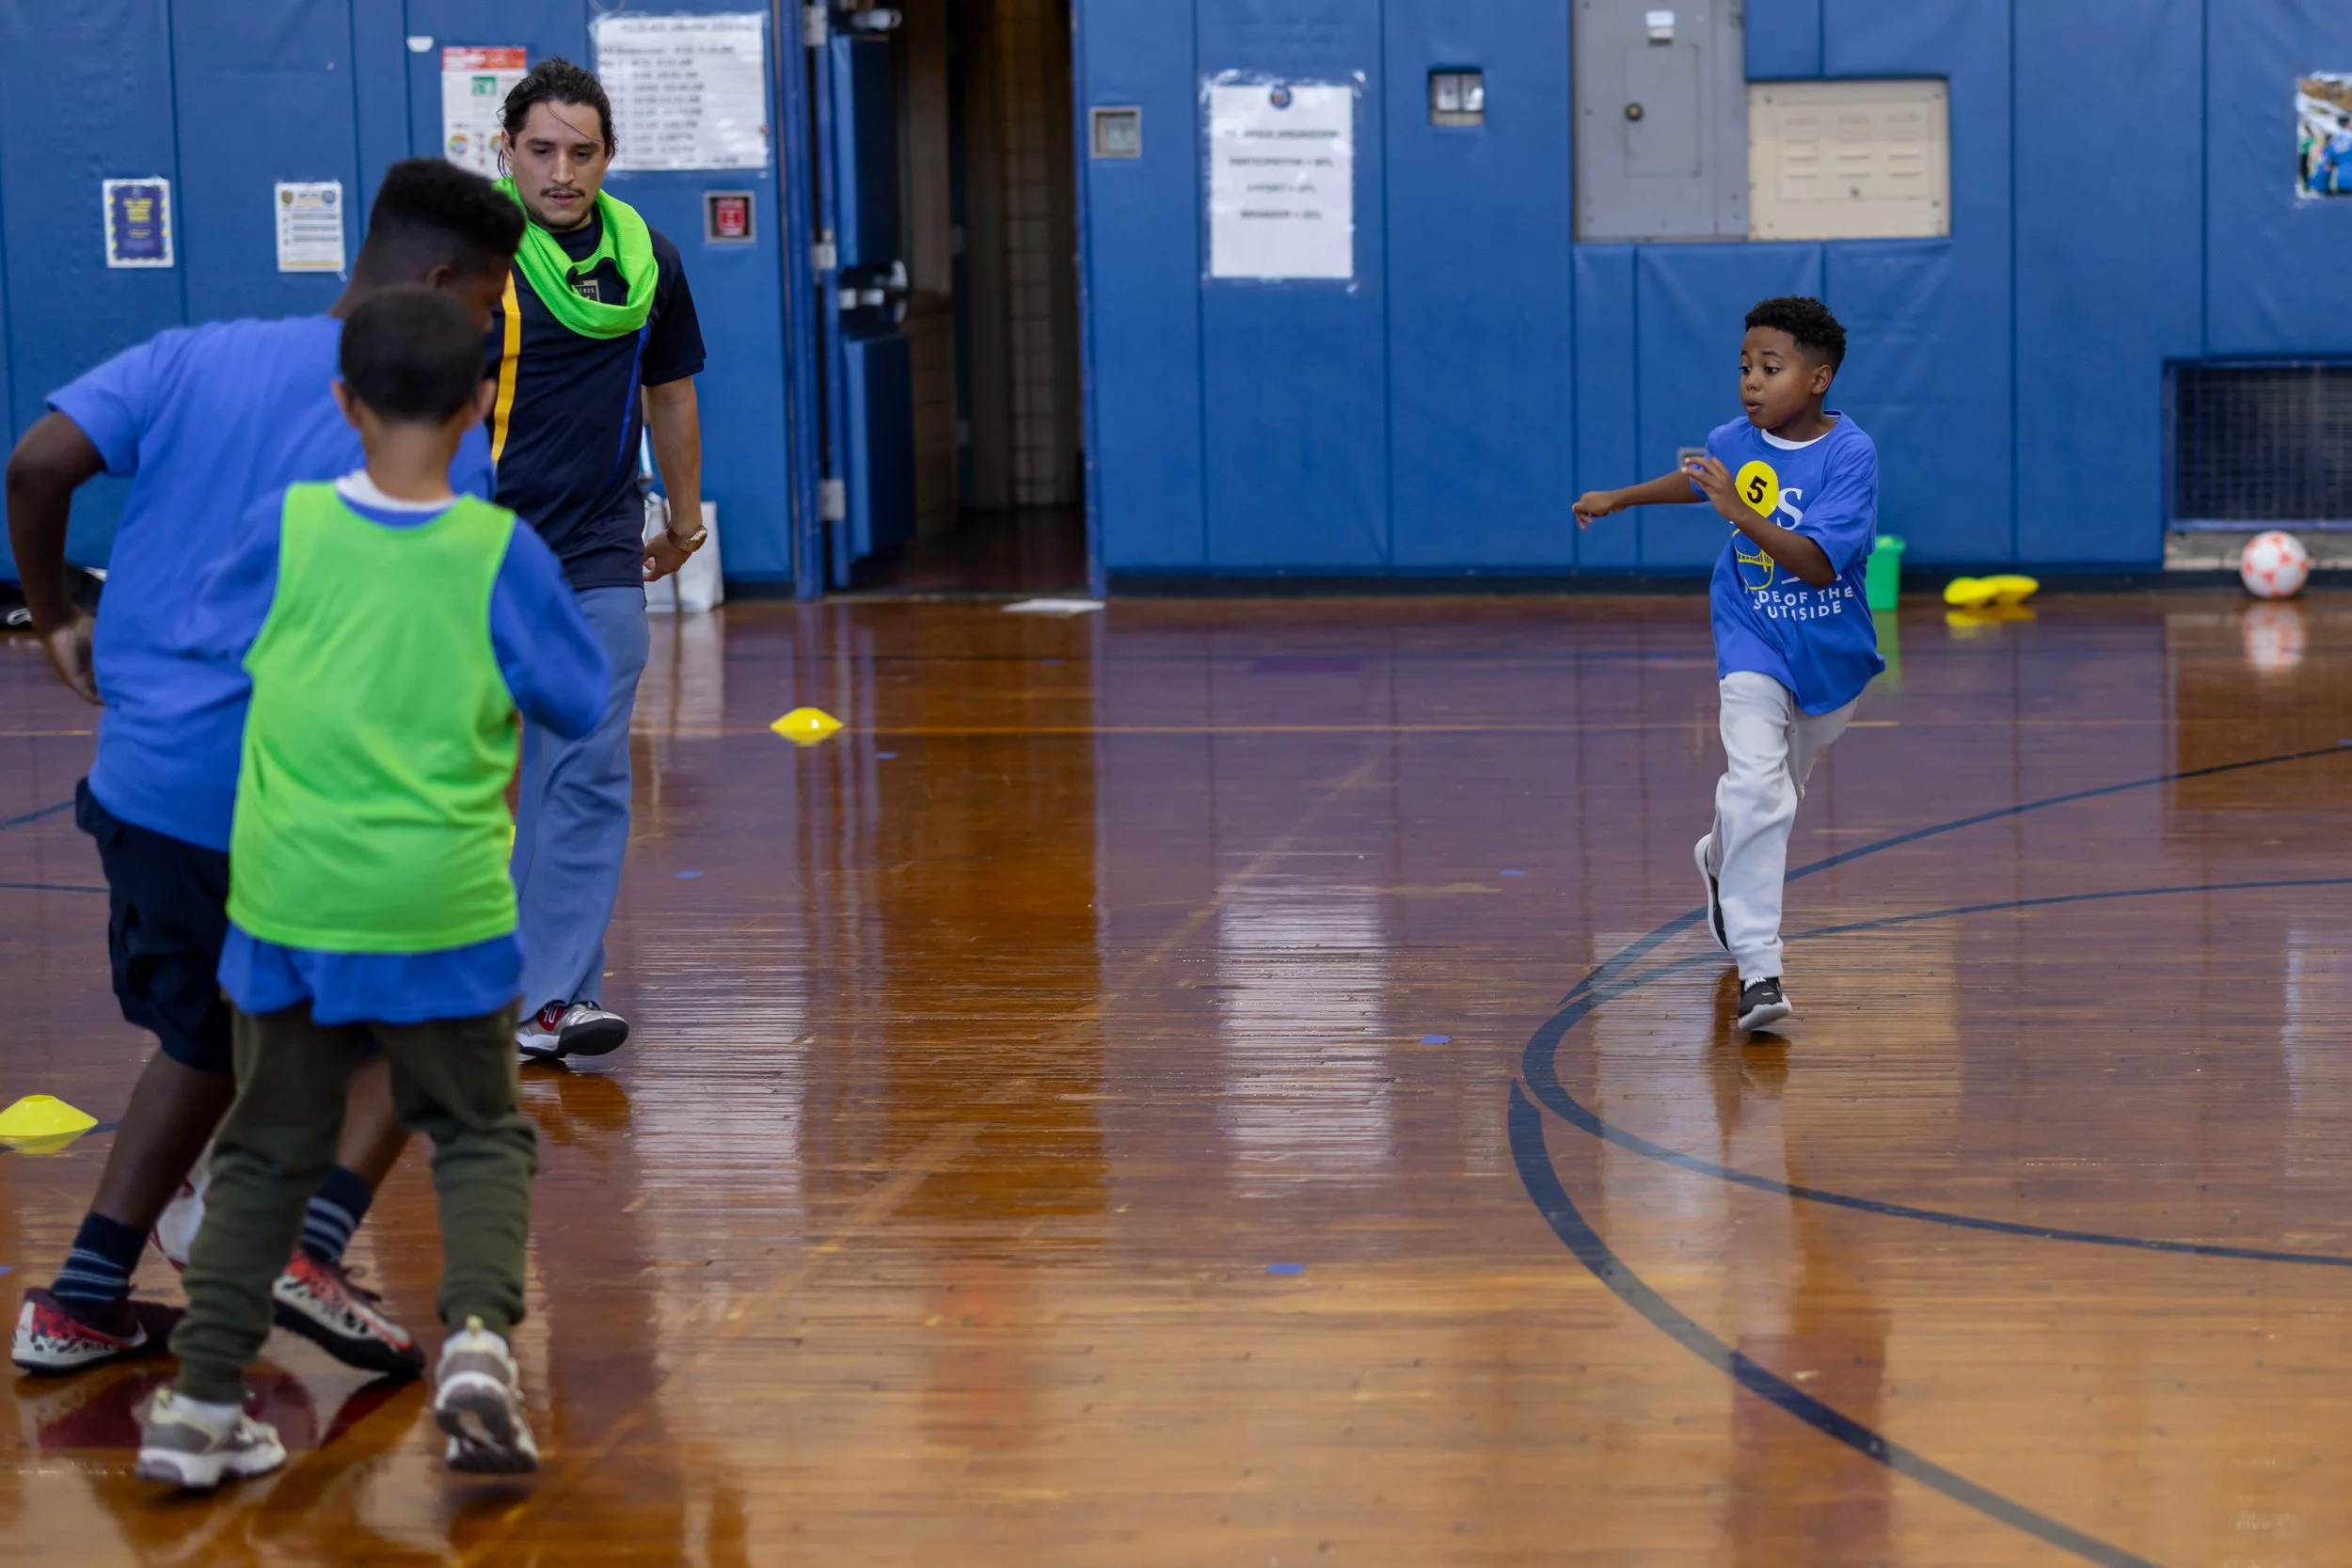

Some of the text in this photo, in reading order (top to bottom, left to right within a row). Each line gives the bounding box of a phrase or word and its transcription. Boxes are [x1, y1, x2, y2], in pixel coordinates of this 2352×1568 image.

[1747, 475, 1768, 504] 5
[1784, 592, 1808, 607] OF
[1818, 586, 1853, 603] THE
